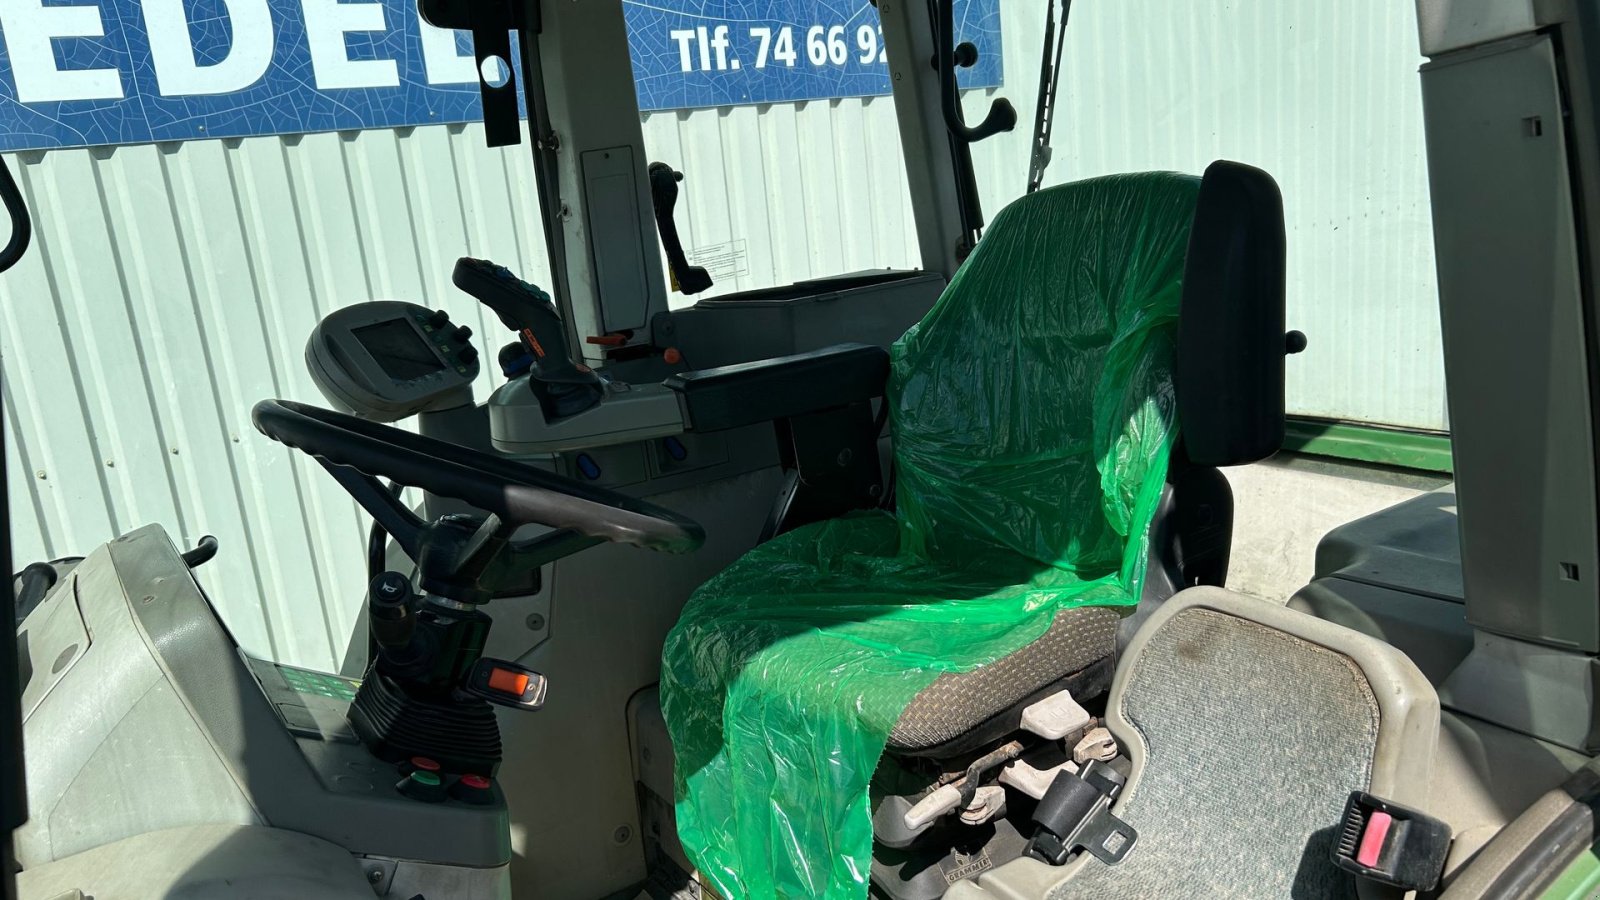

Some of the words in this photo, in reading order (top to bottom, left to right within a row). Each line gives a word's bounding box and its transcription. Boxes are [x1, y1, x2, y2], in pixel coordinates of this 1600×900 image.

[671, 25, 740, 72] Tlf.
[750, 27, 797, 68] 74
[806, 26, 847, 66] 66
[949, 859, 989, 881] GRAMMER
